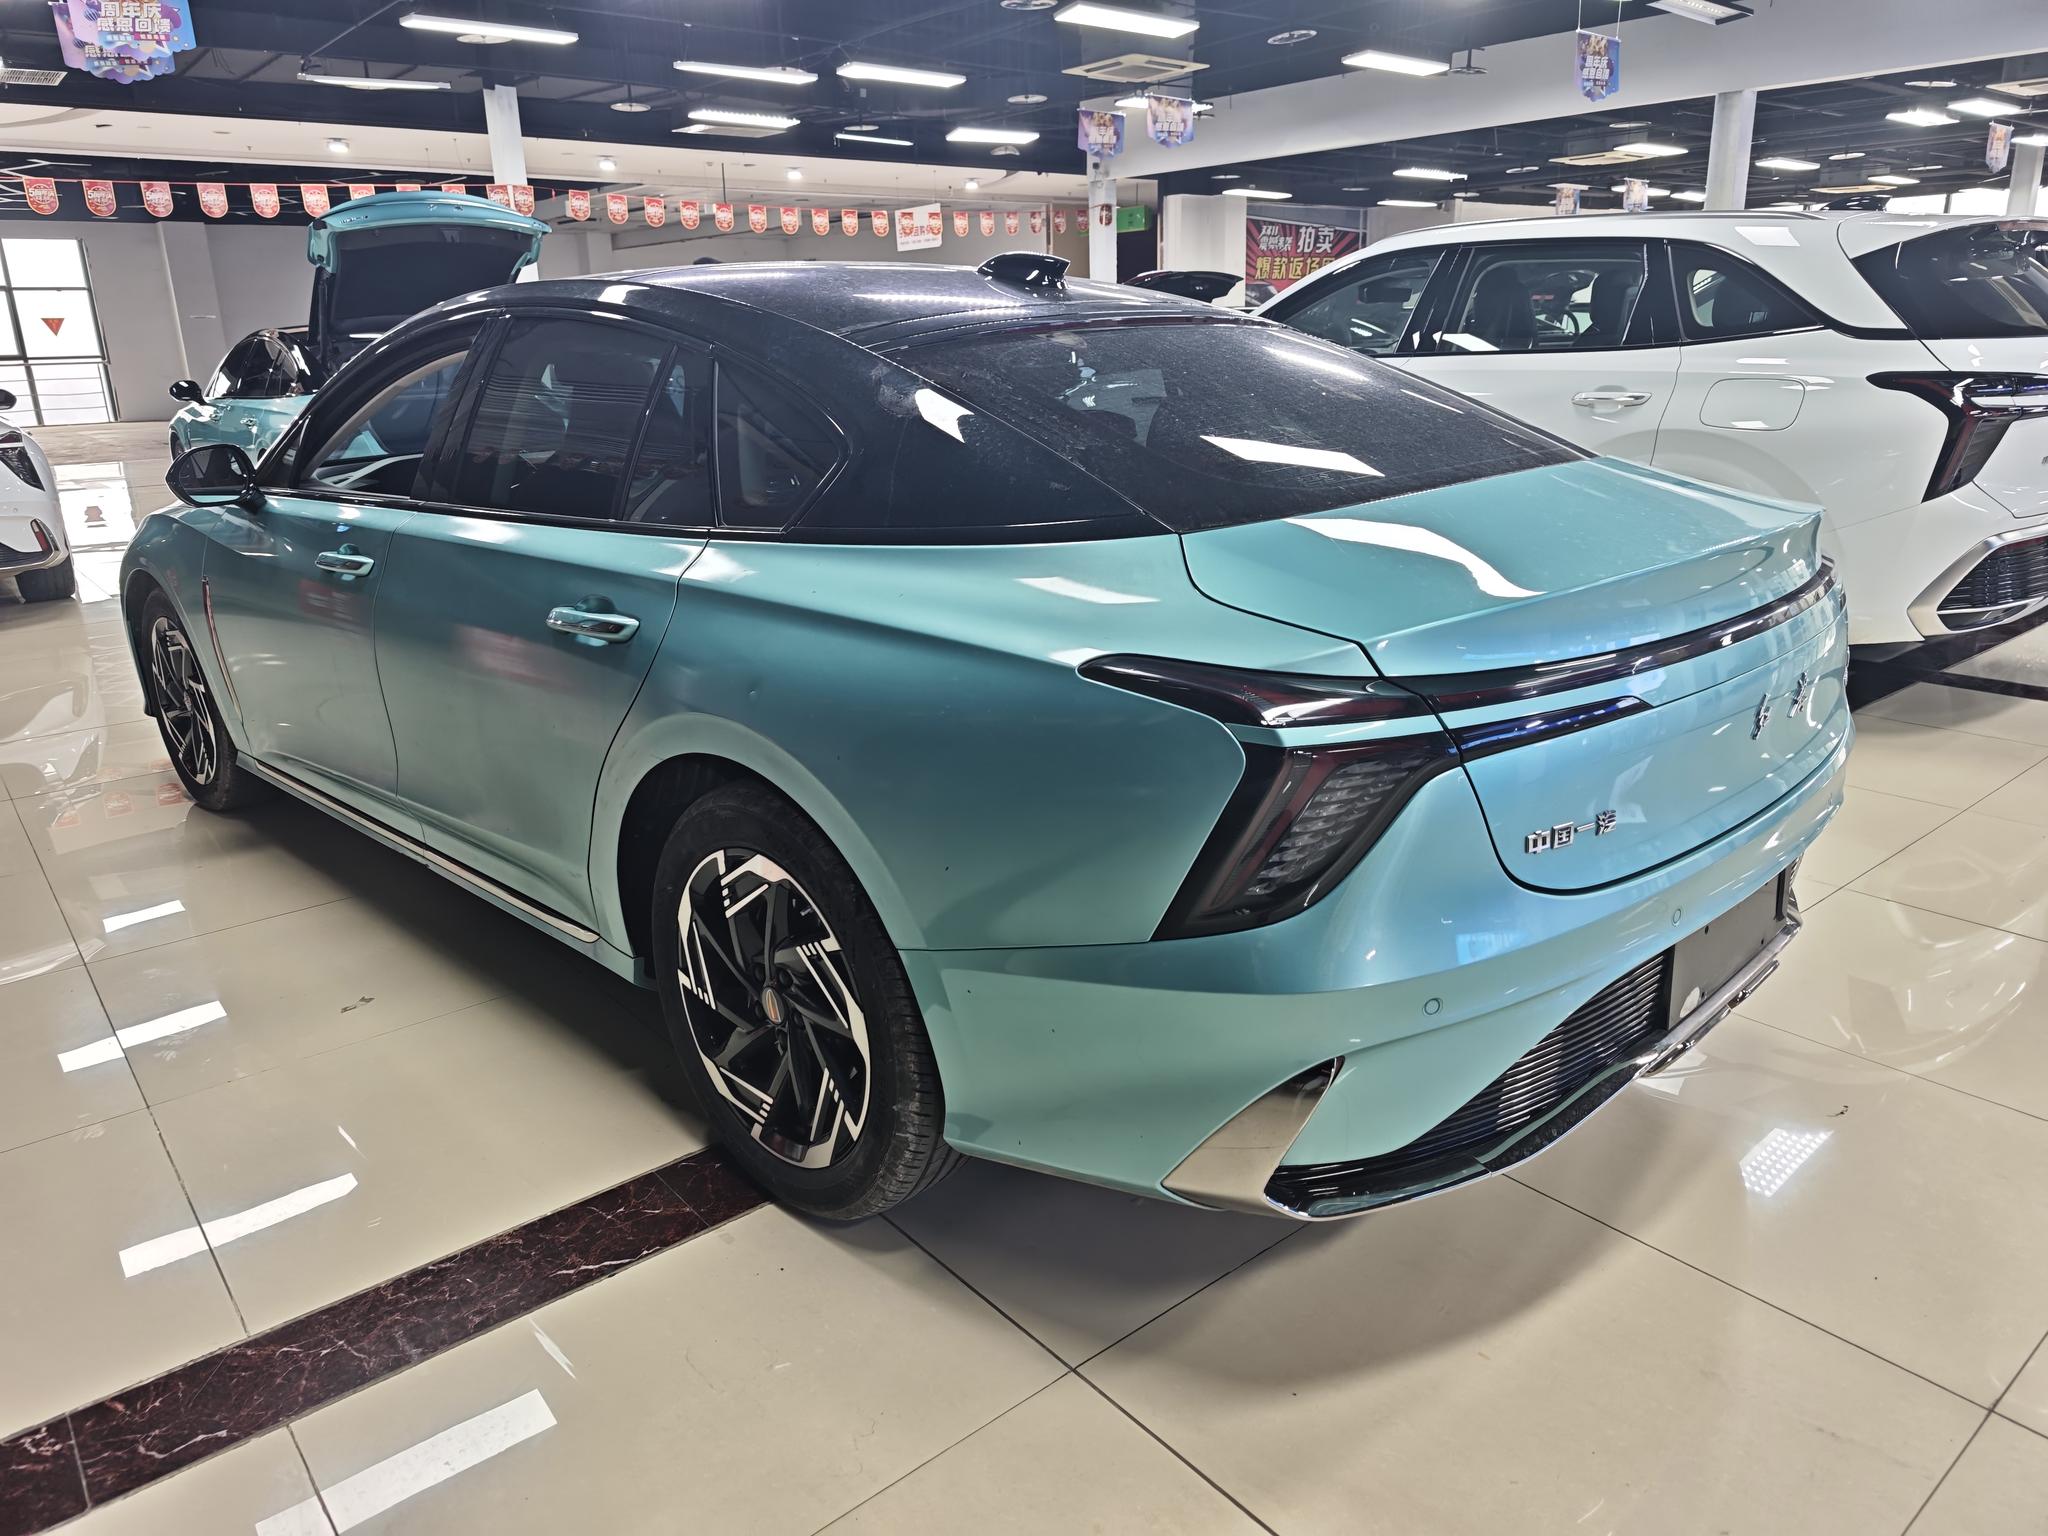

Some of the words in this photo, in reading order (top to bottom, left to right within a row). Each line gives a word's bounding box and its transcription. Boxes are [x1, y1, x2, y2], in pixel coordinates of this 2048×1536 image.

[101, 1, 161, 18] 周年庆
[98, 18, 171, 33] 感恩回馈
[1297, 226, 1334, 253] 拍卖
[1525, 809, 1616, 854] 中国一汽
